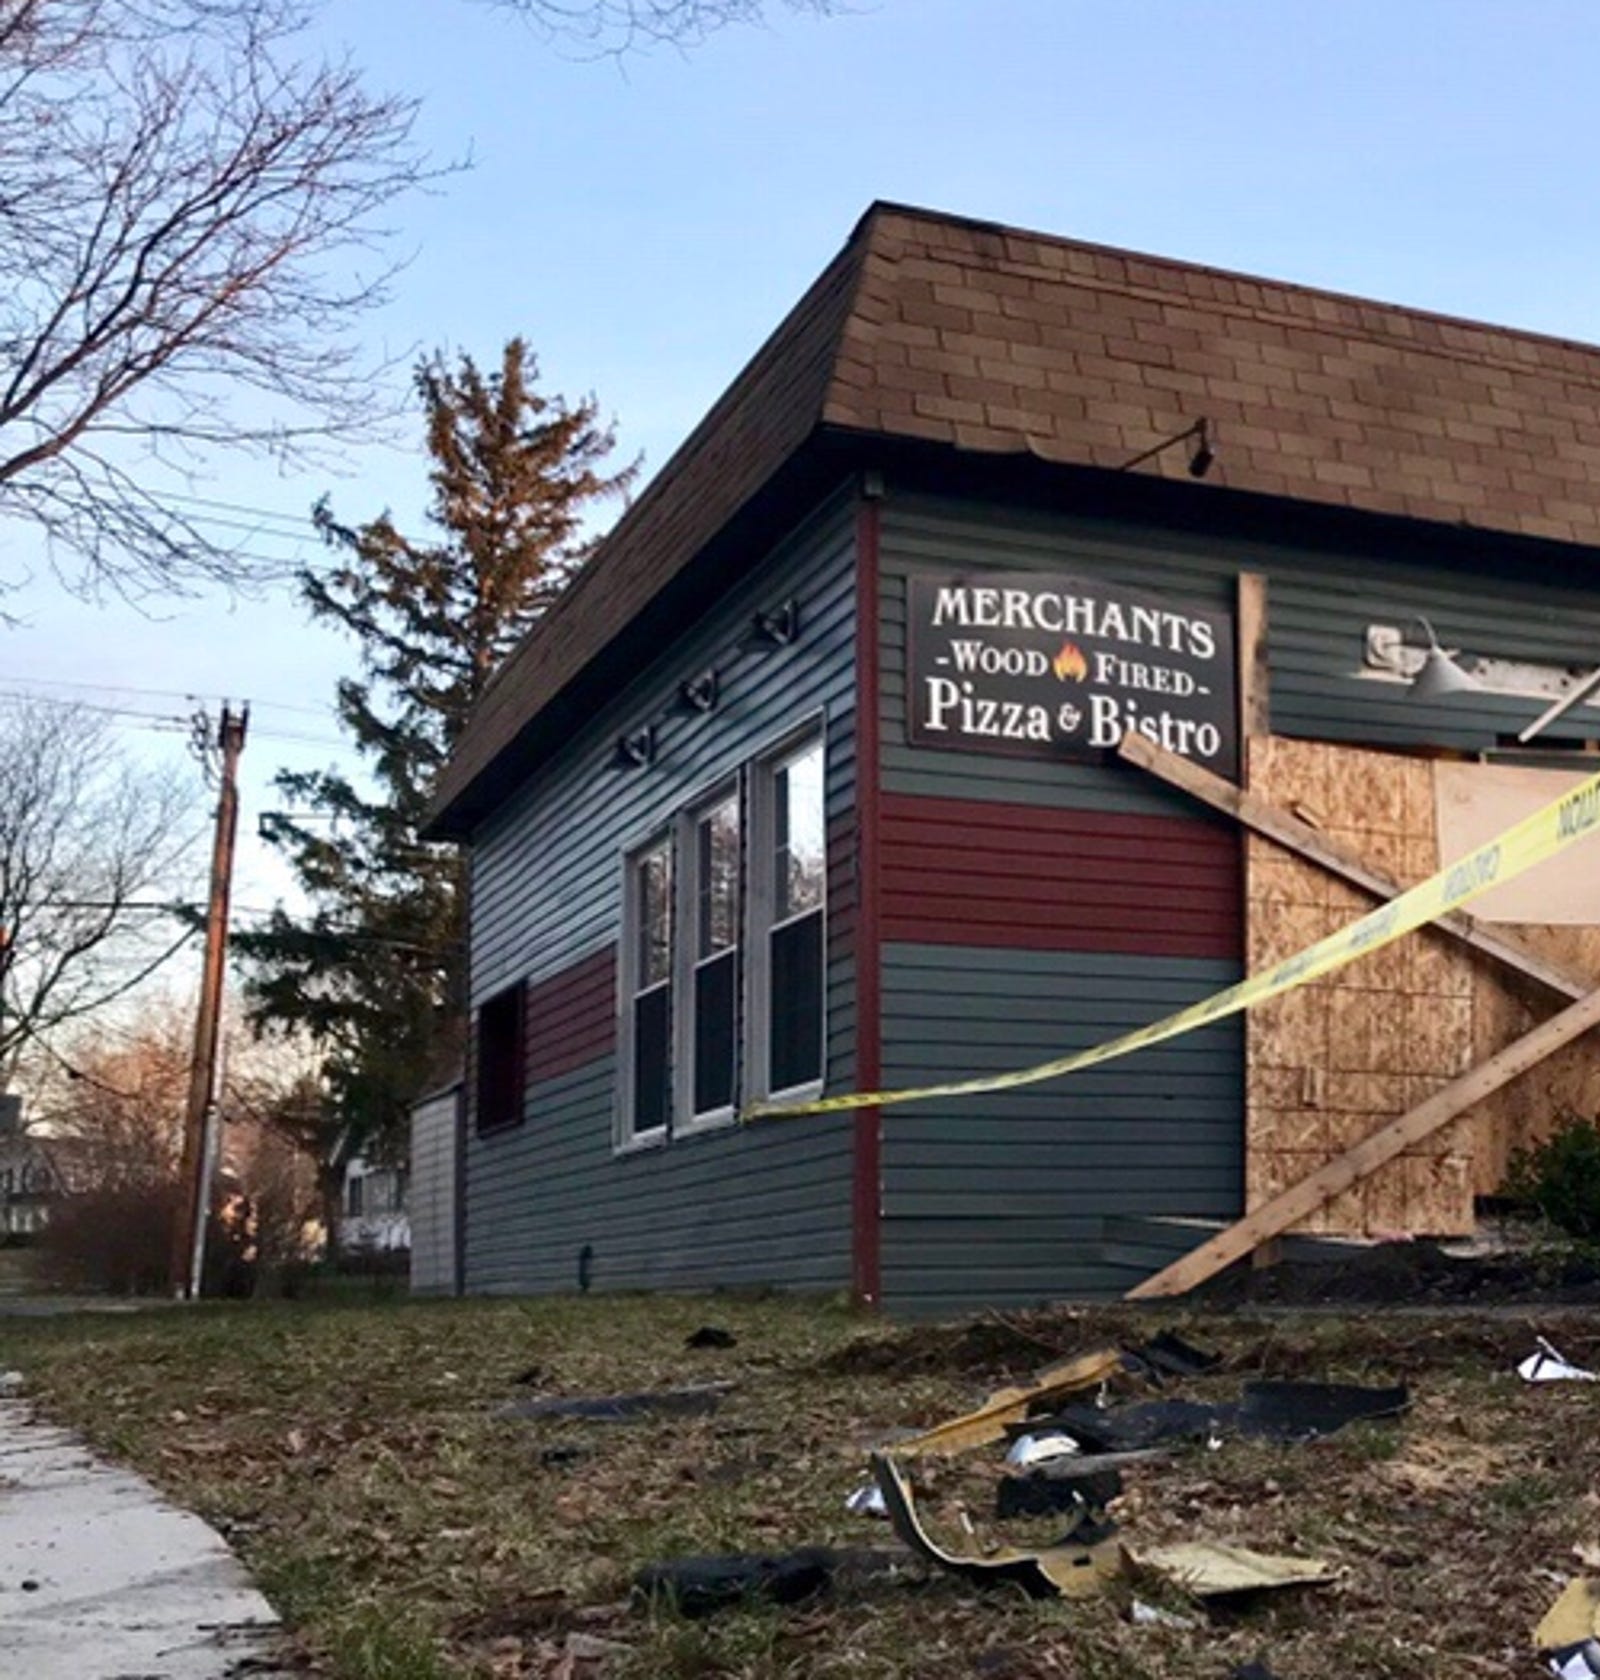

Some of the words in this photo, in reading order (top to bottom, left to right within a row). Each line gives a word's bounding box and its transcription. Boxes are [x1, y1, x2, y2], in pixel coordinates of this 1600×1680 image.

[932, 587, 1216, 659] MERCHANTS
[923, 676, 1052, 742] Pizza
[1057, 703, 1082, 732] &
[1088, 693, 1221, 757] Bistro
